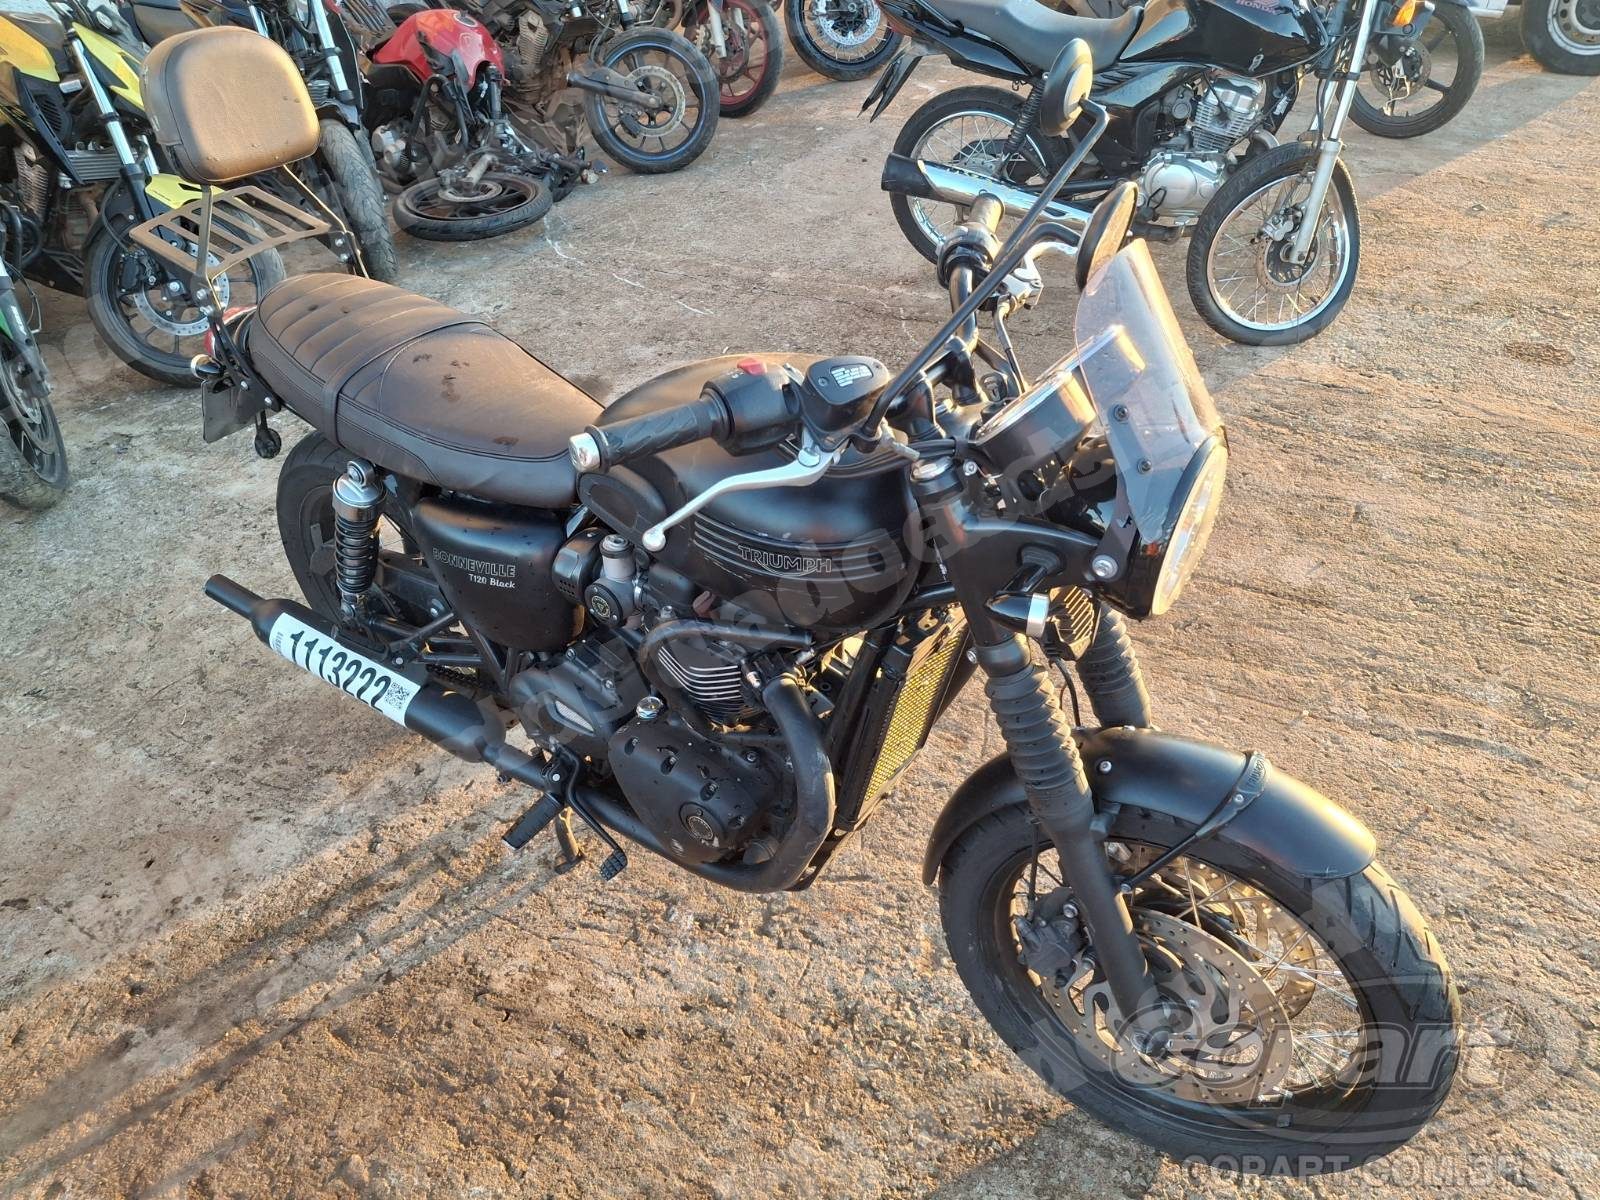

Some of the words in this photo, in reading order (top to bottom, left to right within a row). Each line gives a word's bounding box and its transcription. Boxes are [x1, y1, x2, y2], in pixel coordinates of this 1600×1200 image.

[432, 548, 516, 578] BONNEVILLE
[738, 544, 832, 575] TRIUMPH
[469, 573, 487, 585] T120
[490, 577, 516, 589] Black
[290, 630, 392, 713] 1113222
